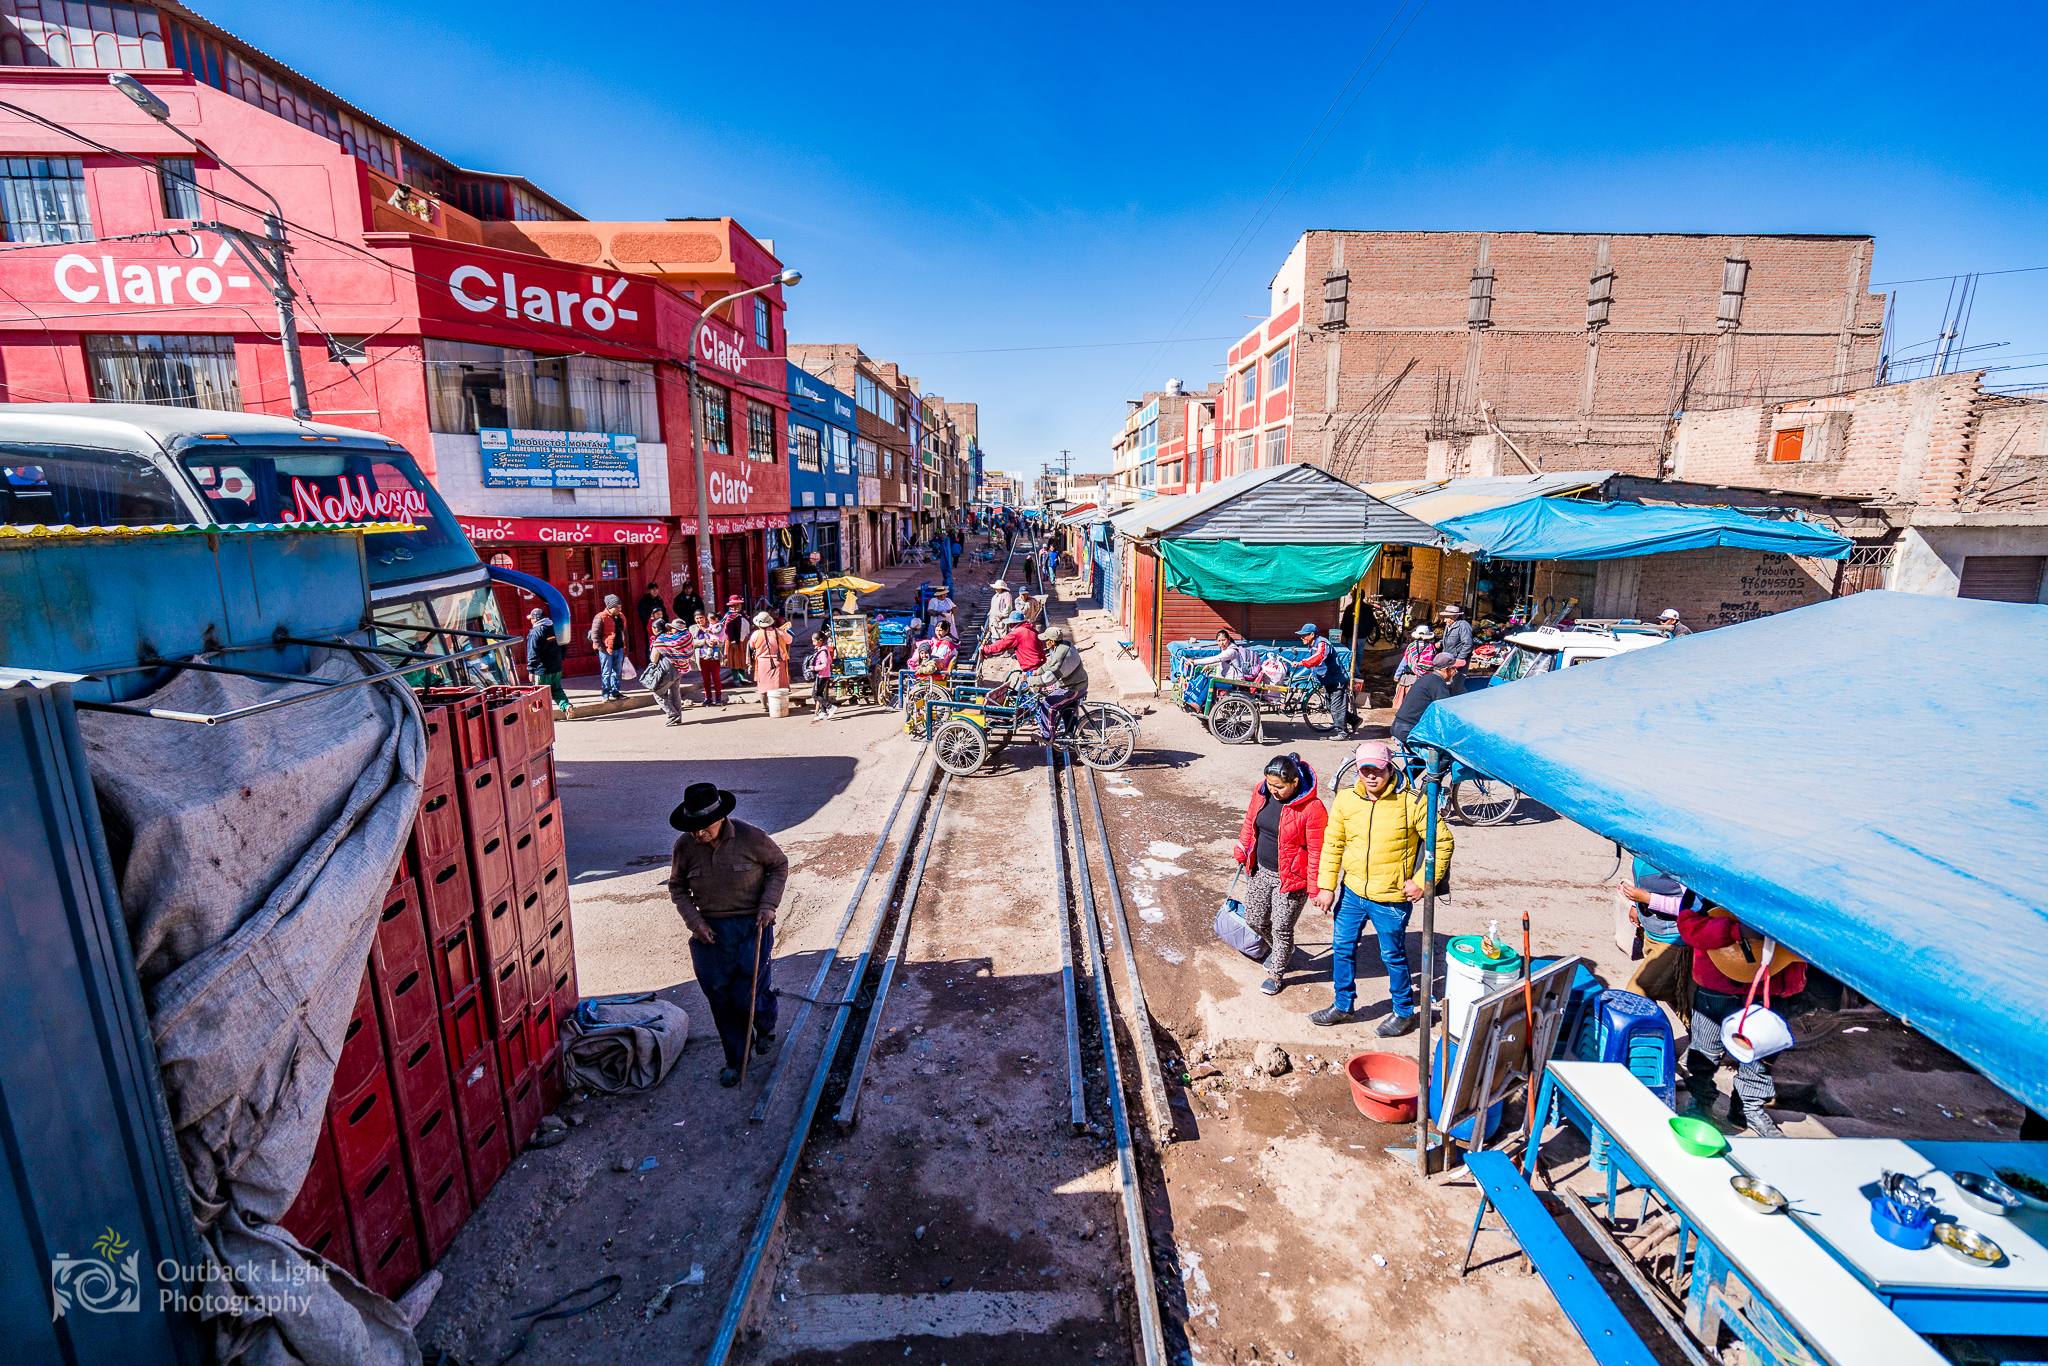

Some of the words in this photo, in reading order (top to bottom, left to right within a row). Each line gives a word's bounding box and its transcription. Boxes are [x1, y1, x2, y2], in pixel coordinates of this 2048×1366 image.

[53, 253, 223, 304] Claro
[449, 265, 615, 331] Claro
[700, 324, 742, 374] Claro
[511, 429, 567, 440] INSUMOS
[514, 439, 567, 447] PRODUCTOS
[709, 471, 748, 505] Claro
[281, 474, 427, 528] Nobleza
[461, 523, 505, 539] Claro
[539, 527, 584, 542] Claro
[614, 529, 654, 543] Claro
[1755, 564, 1796, 576] tubular
[1539, 626, 1555, 635] TAXI
